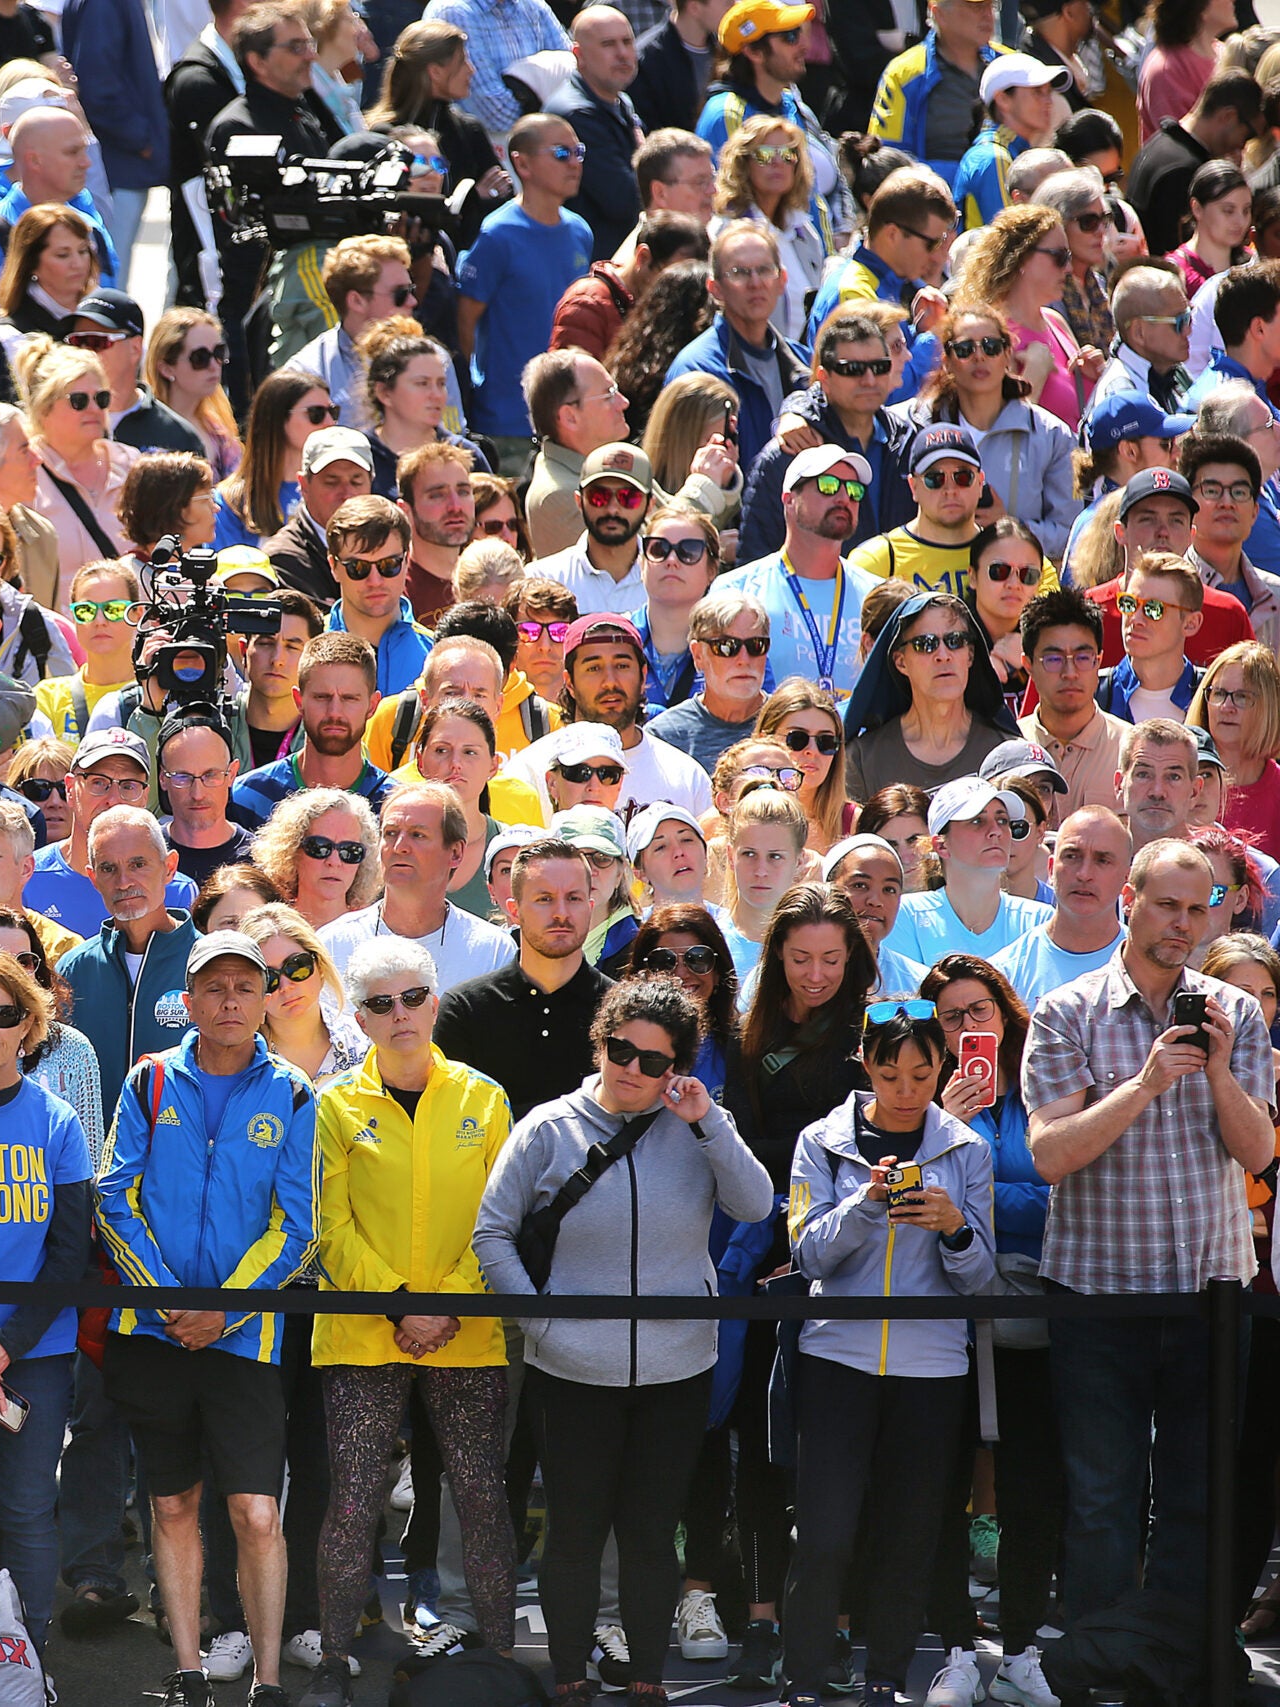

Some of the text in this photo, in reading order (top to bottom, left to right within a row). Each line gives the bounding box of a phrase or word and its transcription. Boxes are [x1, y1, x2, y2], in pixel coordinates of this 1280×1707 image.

[925, 431, 963, 448] MIT
[1151, 471, 1171, 490] B
[1028, 744, 1044, 761] B
